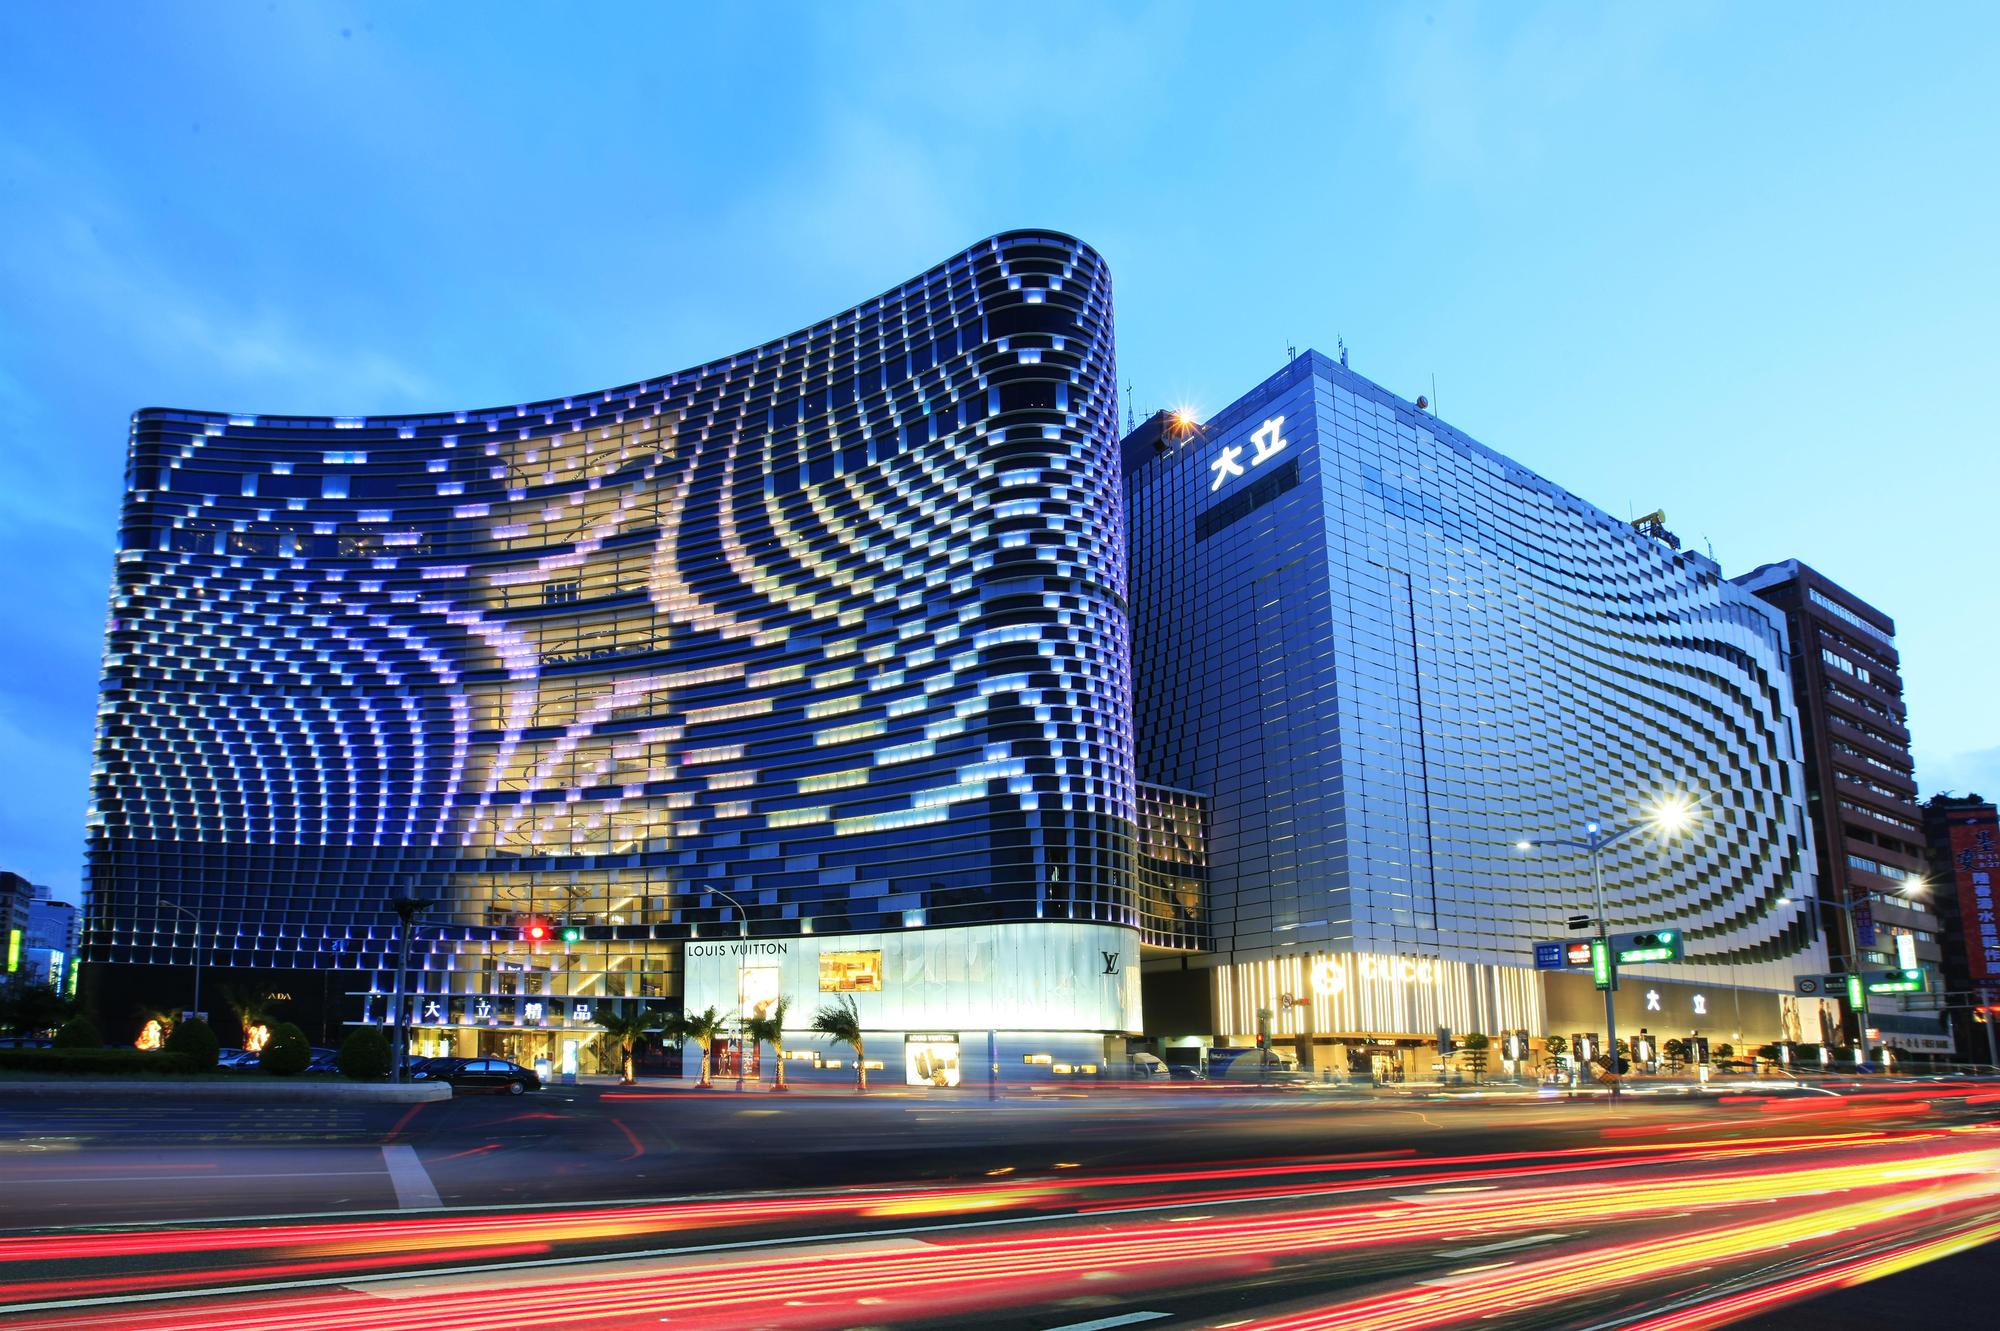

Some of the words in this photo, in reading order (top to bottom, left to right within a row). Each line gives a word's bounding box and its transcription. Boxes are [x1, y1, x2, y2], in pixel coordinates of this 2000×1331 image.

[1210, 415, 1287, 491] 大立
[689, 945, 725, 957] LOUIS
[731, 943, 787, 956] VUITTON
[1359, 957, 1442, 984] GUCCI
[424, 1001, 591, 1022] 大立精品
[1646, 989, 1707, 1015] 大立
